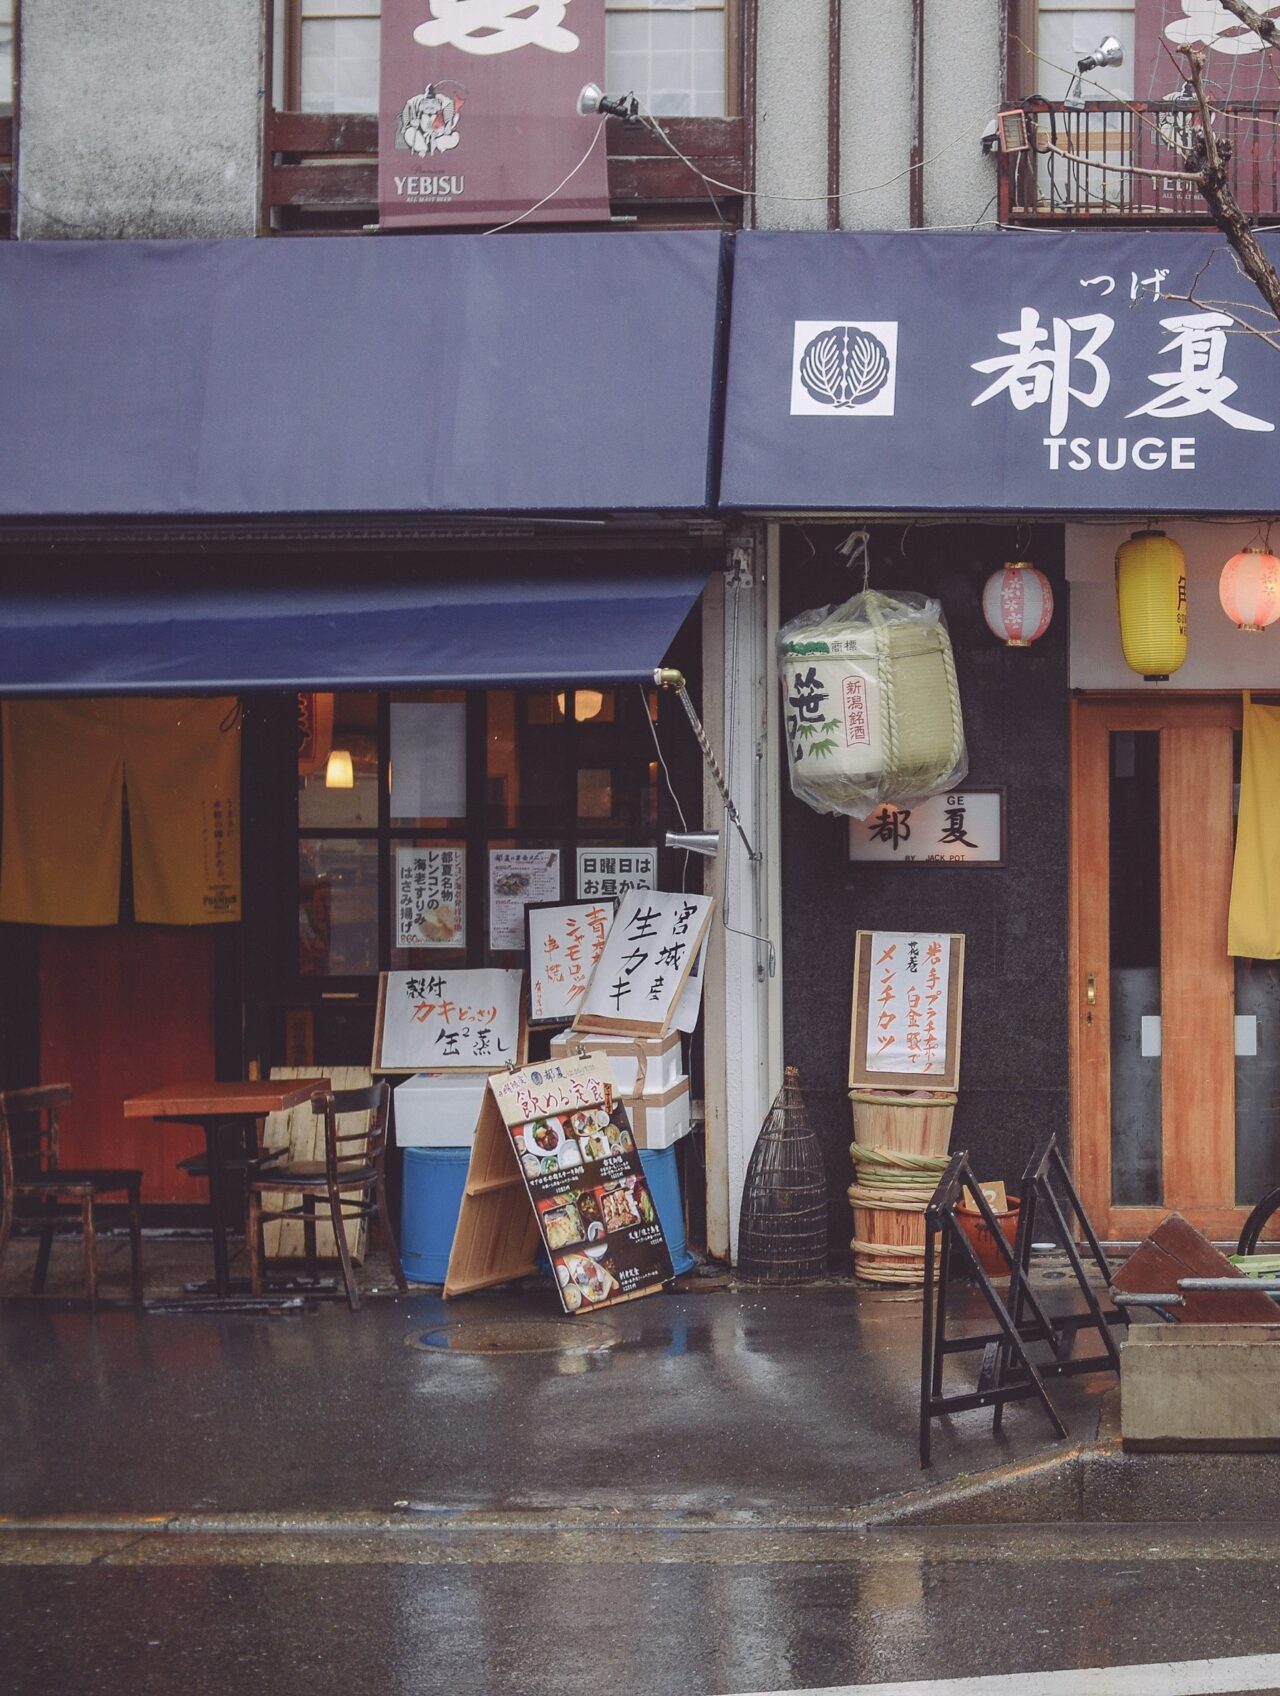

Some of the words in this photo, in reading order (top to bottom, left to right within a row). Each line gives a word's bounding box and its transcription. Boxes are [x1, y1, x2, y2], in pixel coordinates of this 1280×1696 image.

[394, 175, 465, 195] YEBISU
[1080, 268, 1170, 302] つげ
[970, 307, 1275, 436] 都夏
[1043, 437, 1196, 470] TSUGE
[846, 680, 866, 741] 新潟銘酒
[869, 808, 979, 851] 都夏
[427, 851, 440, 910] レンコンの
[441, 851, 453, 902] 都夏名物
[584, 858, 651, 874] 日曜日は
[584, 879, 651, 895] お昼から
[609, 905, 662, 1011] 生カキ
[412, 1000, 498, 1025] カキどっさり
[875, 944, 897, 1056] メンチカツ
[544, 1067, 567, 1082] 都夏
[516, 1078, 604, 1118] 飲める定食
